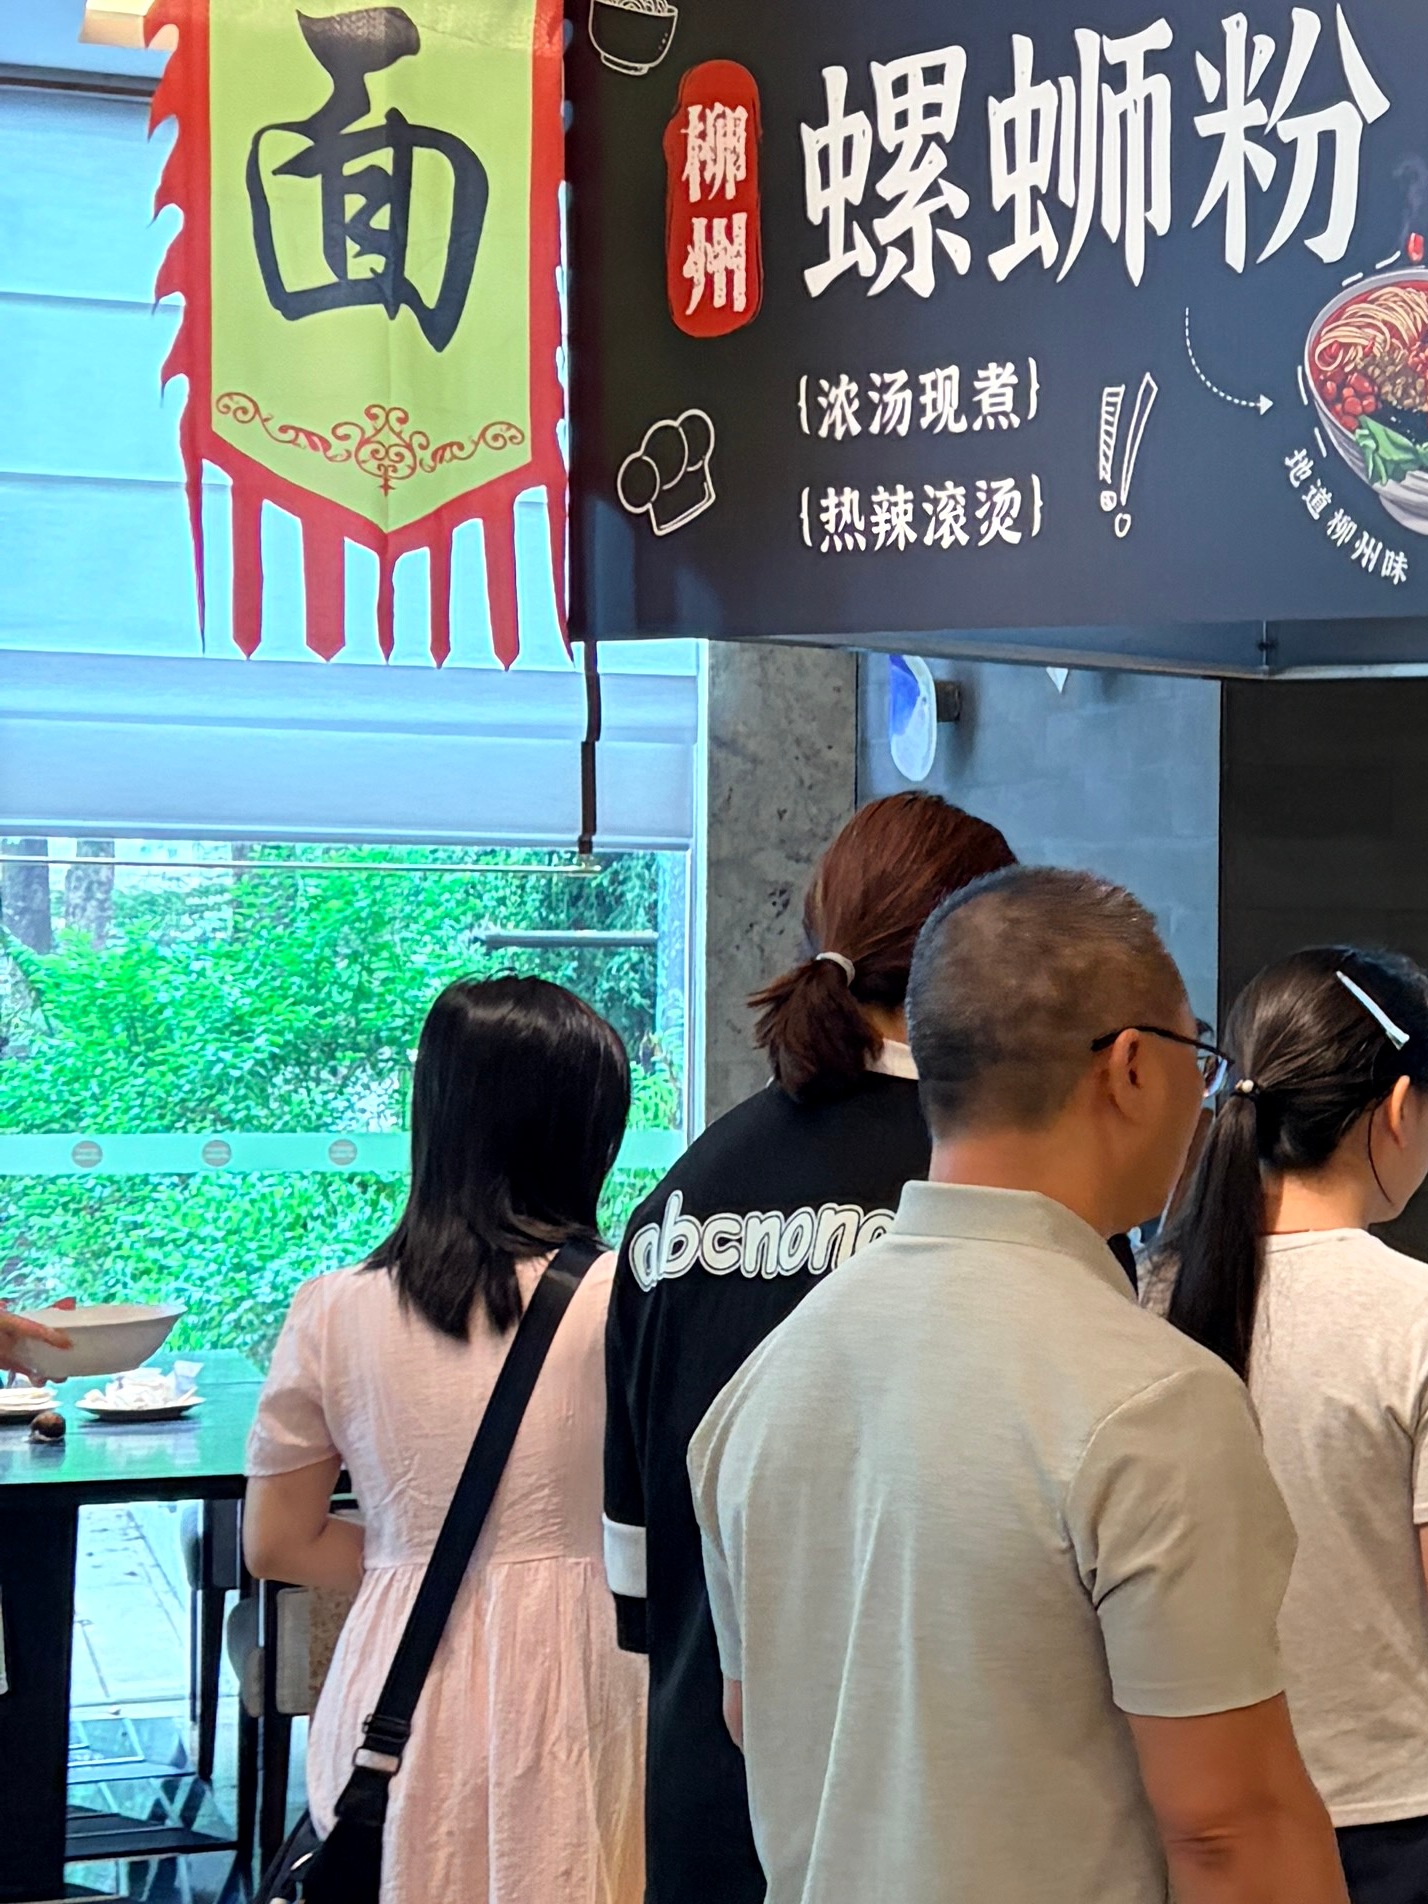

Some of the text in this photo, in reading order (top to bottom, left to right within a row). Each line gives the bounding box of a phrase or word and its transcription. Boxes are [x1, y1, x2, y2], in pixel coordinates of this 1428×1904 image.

[246, 5, 490, 353] 面
[680, 101, 749, 316] 柳州
[800, 2, 1391, 298] 螺蛳粉
[1284, 448, 1409, 586] 地道柳州味
